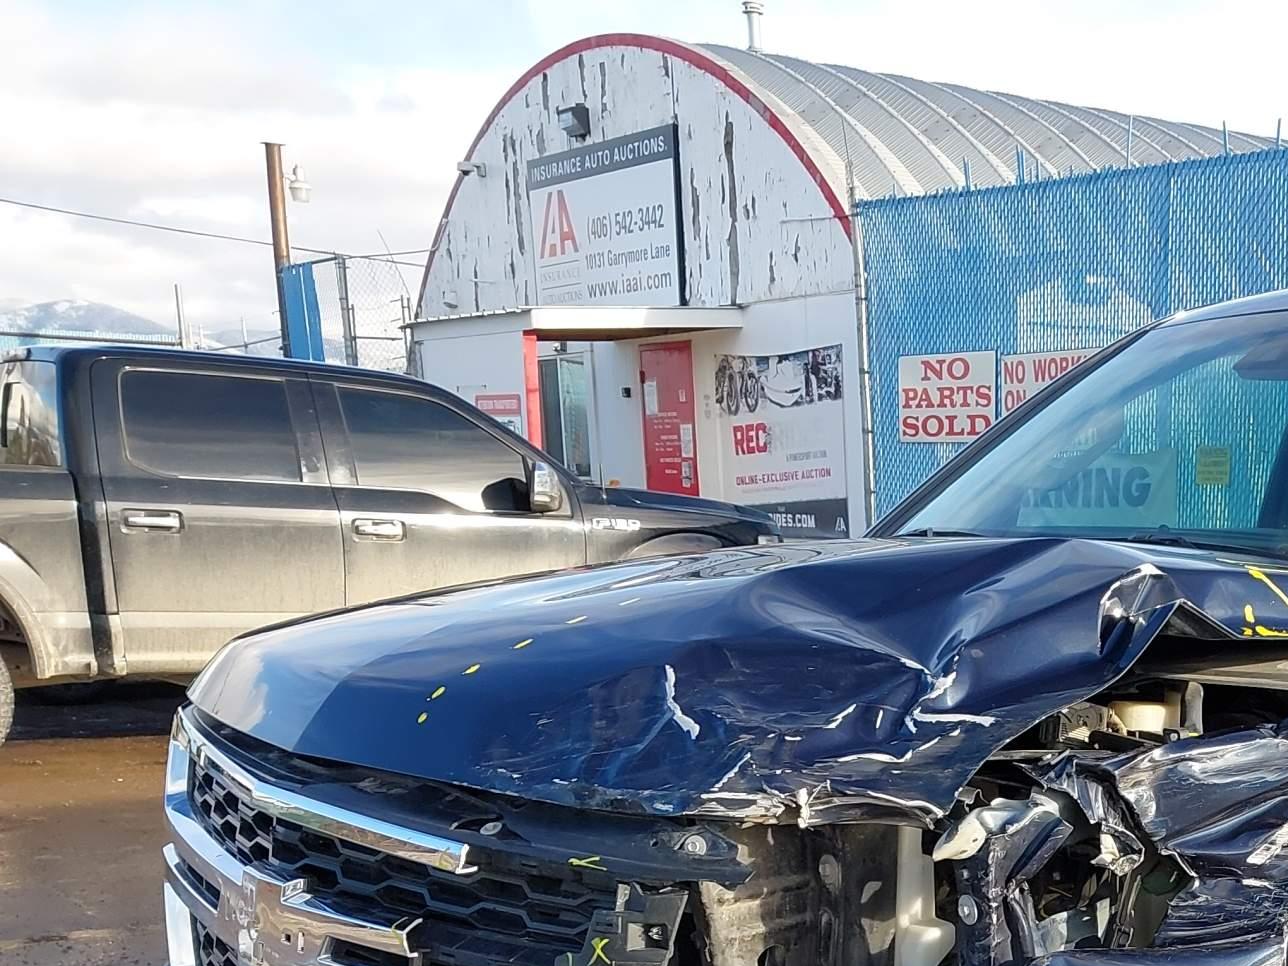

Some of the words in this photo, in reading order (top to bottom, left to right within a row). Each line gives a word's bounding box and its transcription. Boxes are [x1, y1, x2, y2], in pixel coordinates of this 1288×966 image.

[531, 156, 582, 184] INSURANCE
[584, 149, 610, 169] AUTO
[587, 212, 612, 244] (406)
[615, 203, 665, 236] 542-3442
[585, 250, 606, 270] 10131
[607, 247, 649, 268] Garrymore
[650, 242, 671, 260] Lane
[587, 271, 672, 299] www.iaai.com
[920, 357, 970, 381] NO
[1004, 360, 1026, 385] NO
[1033, 354, 1088, 382] WORK
[902, 385, 992, 409] PARTS
[1004, 389, 1027, 412] ON
[902, 414, 992, 438] SOLD
[736, 470, 799, 486] ONLINE-EXCLUSIVE
[801, 467, 831, 480] AUCTION
